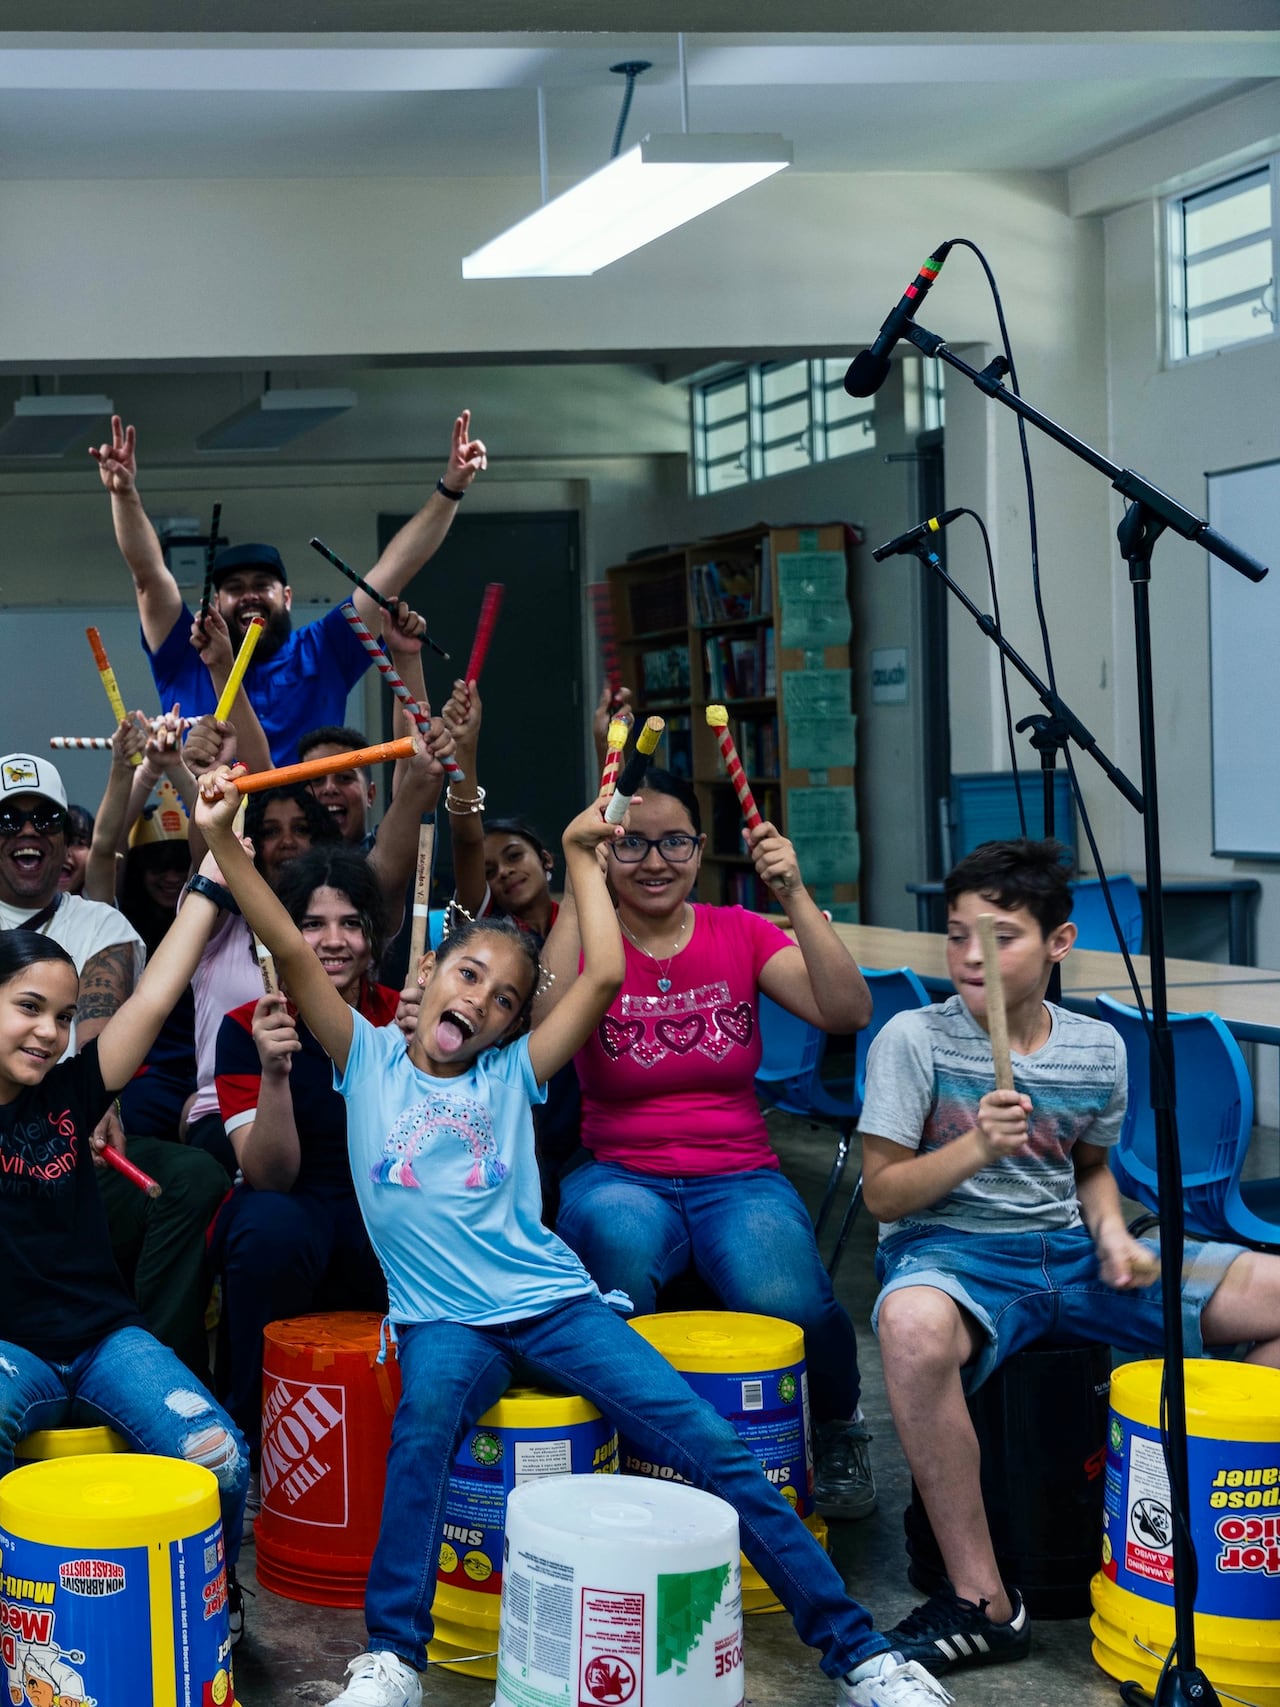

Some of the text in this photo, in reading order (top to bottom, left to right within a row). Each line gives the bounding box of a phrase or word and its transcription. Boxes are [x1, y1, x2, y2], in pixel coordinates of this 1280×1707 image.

[629, 988, 722, 1013] LOVE ME
[261, 1385, 342, 1498] HOM
[280, 1453, 332, 1505] THE
[1134, 1547, 1158, 1562] AVISO
[60, 1560, 124, 1579] GREASE BUSTER
[1127, 1558, 1164, 1580] WARNING
[61, 1577, 124, 1597] NON ABRASIVE
[181, 1629, 189, 1646] con
[182, 1645, 190, 1673] Doctor
